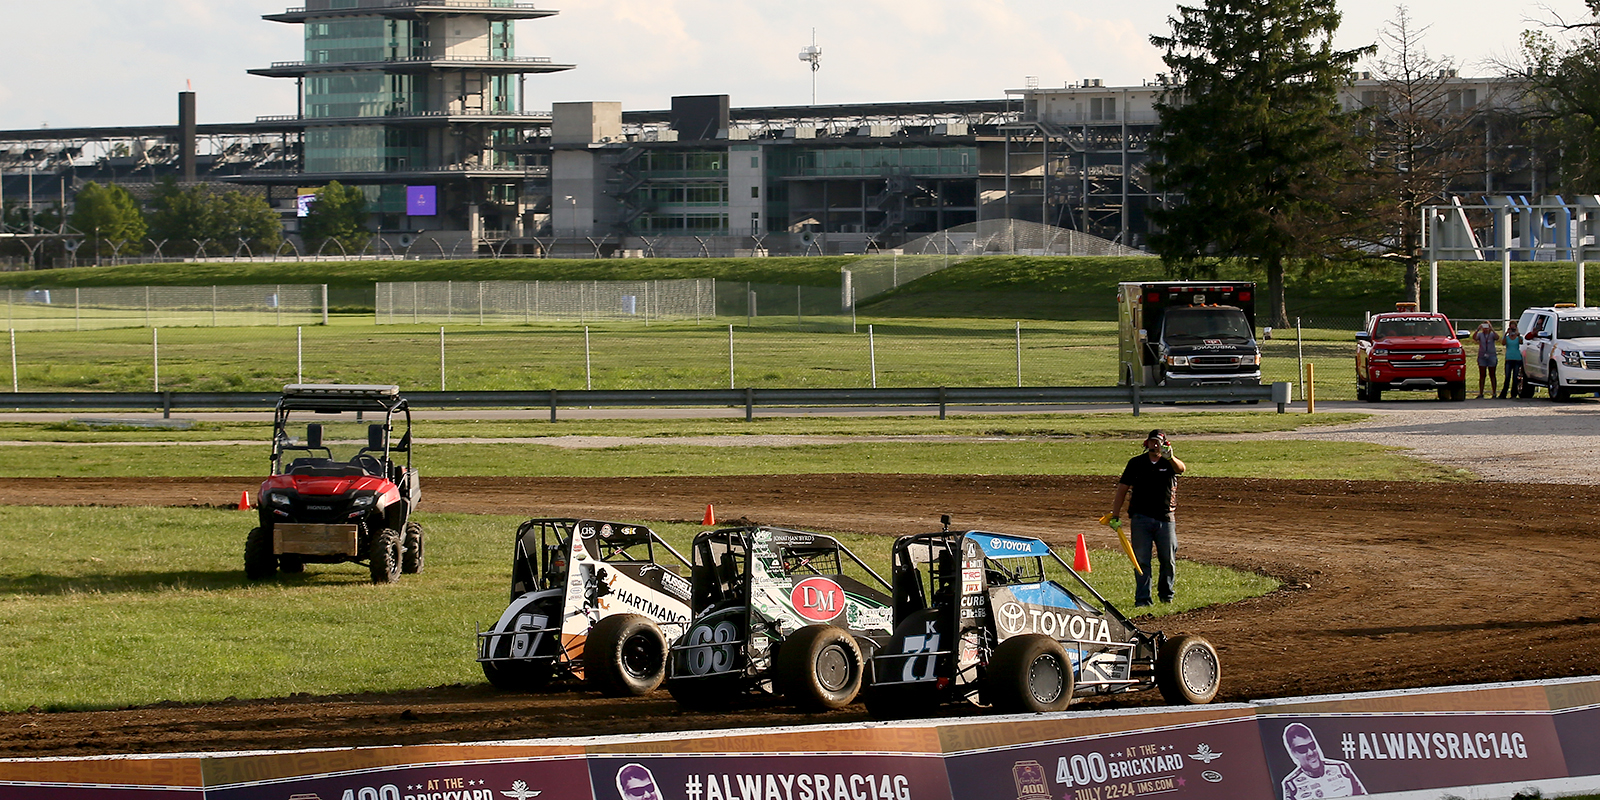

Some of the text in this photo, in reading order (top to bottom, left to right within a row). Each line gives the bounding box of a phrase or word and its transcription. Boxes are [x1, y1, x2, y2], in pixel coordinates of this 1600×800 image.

[1002, 540, 1032, 552] TOYOTA
[617, 588, 676, 622] HARTMAN
[802, 585, 836, 612] DM
[960, 595, 985, 607] CURB
[926, 620, 937, 633] K
[1029, 609, 1112, 643] TOYOTA
[689, 622, 737, 676] 63
[902, 633, 940, 682] 71
[1126, 744, 1158, 758] AT THE
[1341, 732, 1528, 760] #ALWAYSRAC14G
[1056, 751, 1108, 788] 400
[1108, 753, 1184, 779] BRICKYARD
[427, 777, 464, 791] AT THE
[685, 774, 911, 800] #ALWAYSRAC14G
[1022, 784, 1045, 794] 400
[1075, 778, 1174, 800] JULY 22-24 IMS.COM
